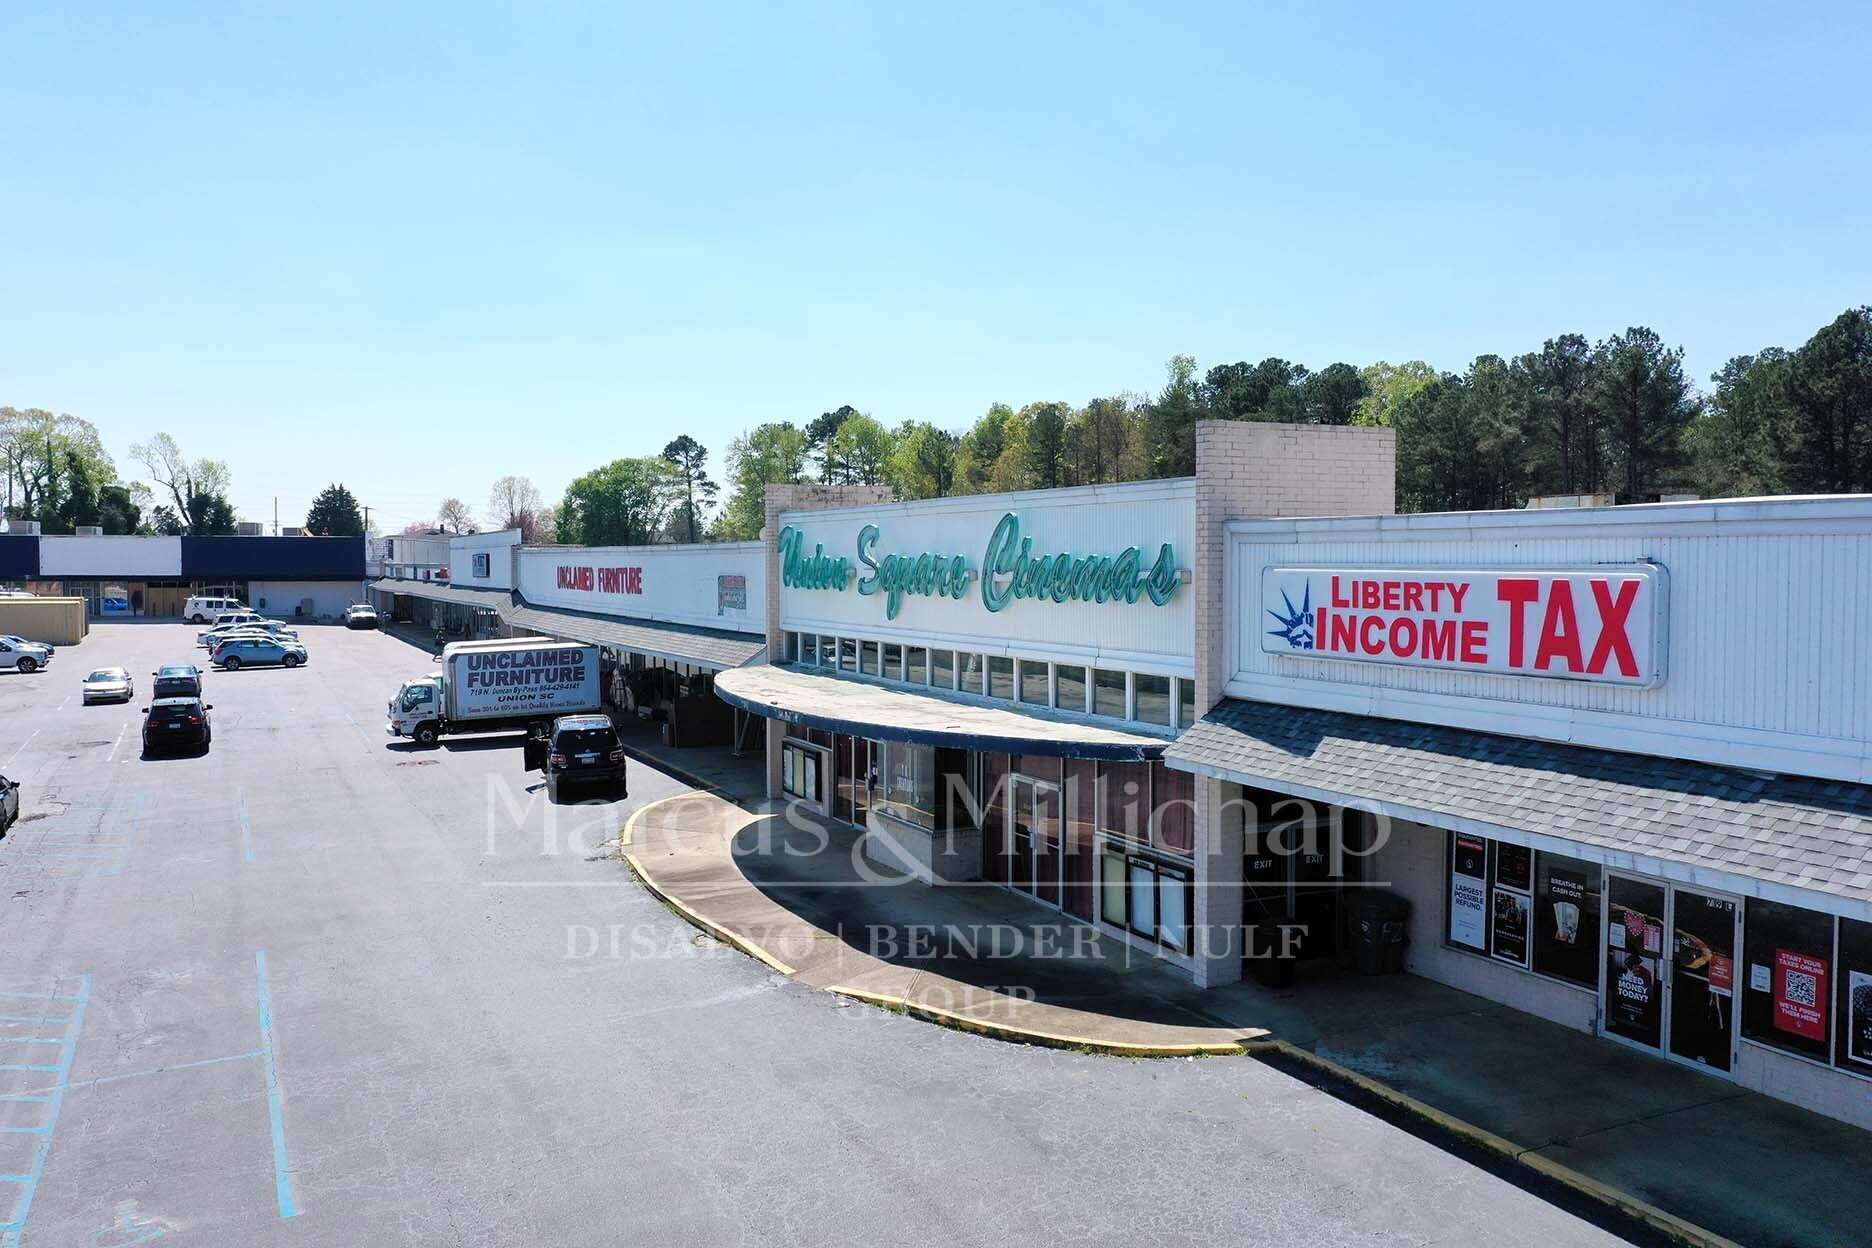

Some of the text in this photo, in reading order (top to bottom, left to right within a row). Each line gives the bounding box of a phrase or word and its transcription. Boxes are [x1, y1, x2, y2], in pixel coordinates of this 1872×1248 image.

[779, 511, 1183, 621] Union Square Cinemas
[556, 566, 643, 595] UNCLAIMED FURNITURE
[1331, 575, 1470, 613] LIBERTY
[1316, 607, 1489, 664] INCOME
[1497, 578, 1641, 678] TAX
[467, 649, 584, 670] UNCLAIMED
[467, 666, 586, 688] FURNITURE
[498, 692, 555, 702] UNION SC
[1254, 859, 1273, 869] EXIT
[1306, 854, 1325, 864] EXIT
[1455, 884, 1483, 897] LARGEST
[1550, 876, 1577, 890] BREATHE
[1552, 885, 1569, 896] CASH
[1454, 889, 1484, 906] POSSIBLE
[1618, 980, 1648, 994] MONEY
[1622, 973, 1644, 985] NEED
[1617, 987, 1649, 1003] TODAY?
